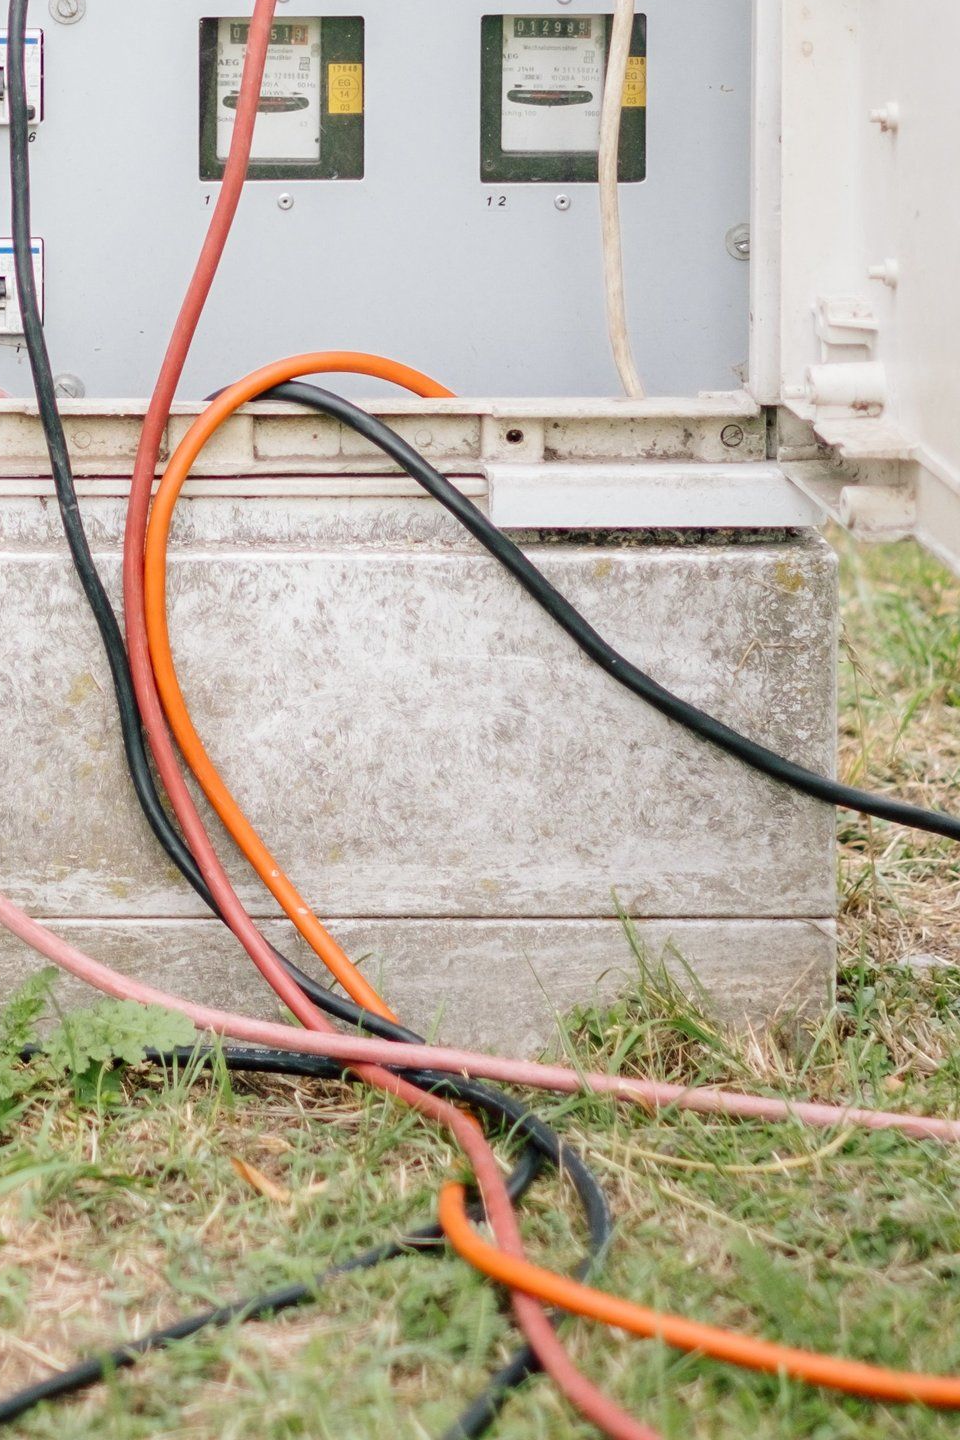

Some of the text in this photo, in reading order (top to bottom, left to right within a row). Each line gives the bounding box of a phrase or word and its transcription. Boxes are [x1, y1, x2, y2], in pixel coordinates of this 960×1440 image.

[338, 79, 351, 87] EG
[28, 131, 36, 142] 6
[204, 195, 210, 204] 1
[487, 196, 506, 206] 12
